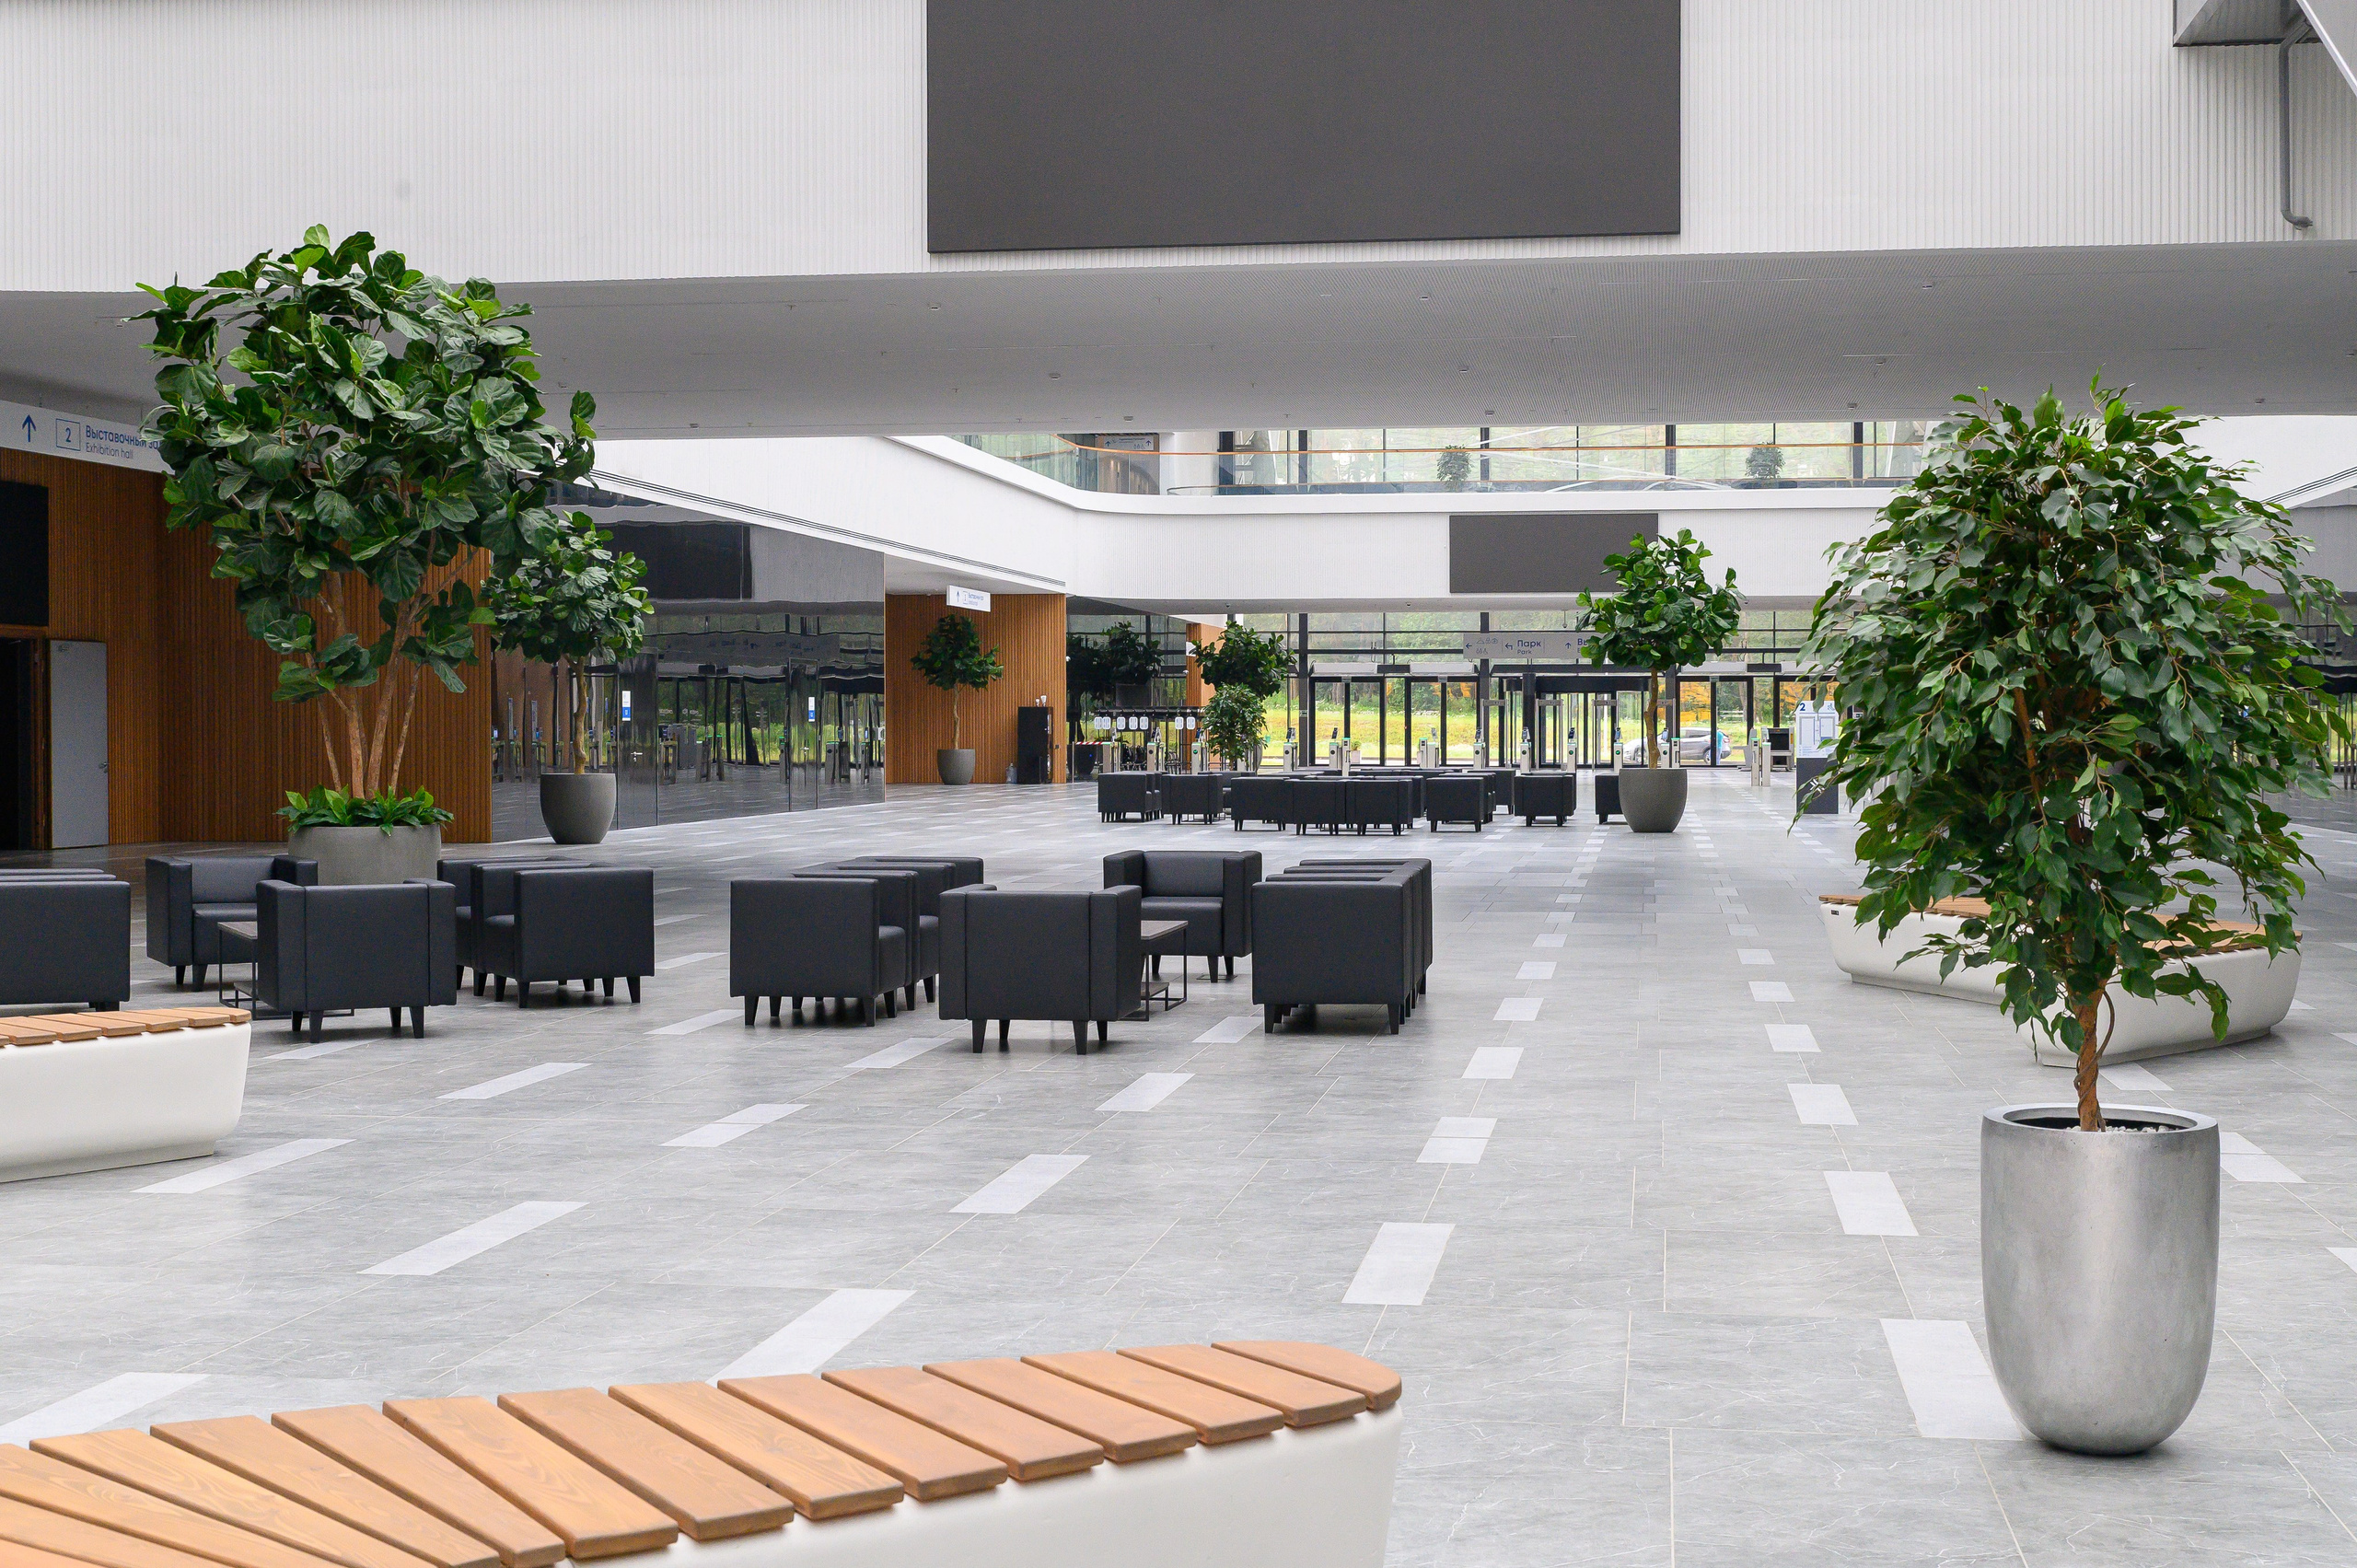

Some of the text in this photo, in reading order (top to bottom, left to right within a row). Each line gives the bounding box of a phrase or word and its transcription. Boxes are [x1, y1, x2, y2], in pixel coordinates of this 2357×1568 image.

[65, 427, 71, 443] 2
[148, 440, 160, 449] за
[86, 442, 134, 459] Exhibition hall
[1517, 639, 1541, 648] Парк
[1799, 703, 1805, 712] 2
